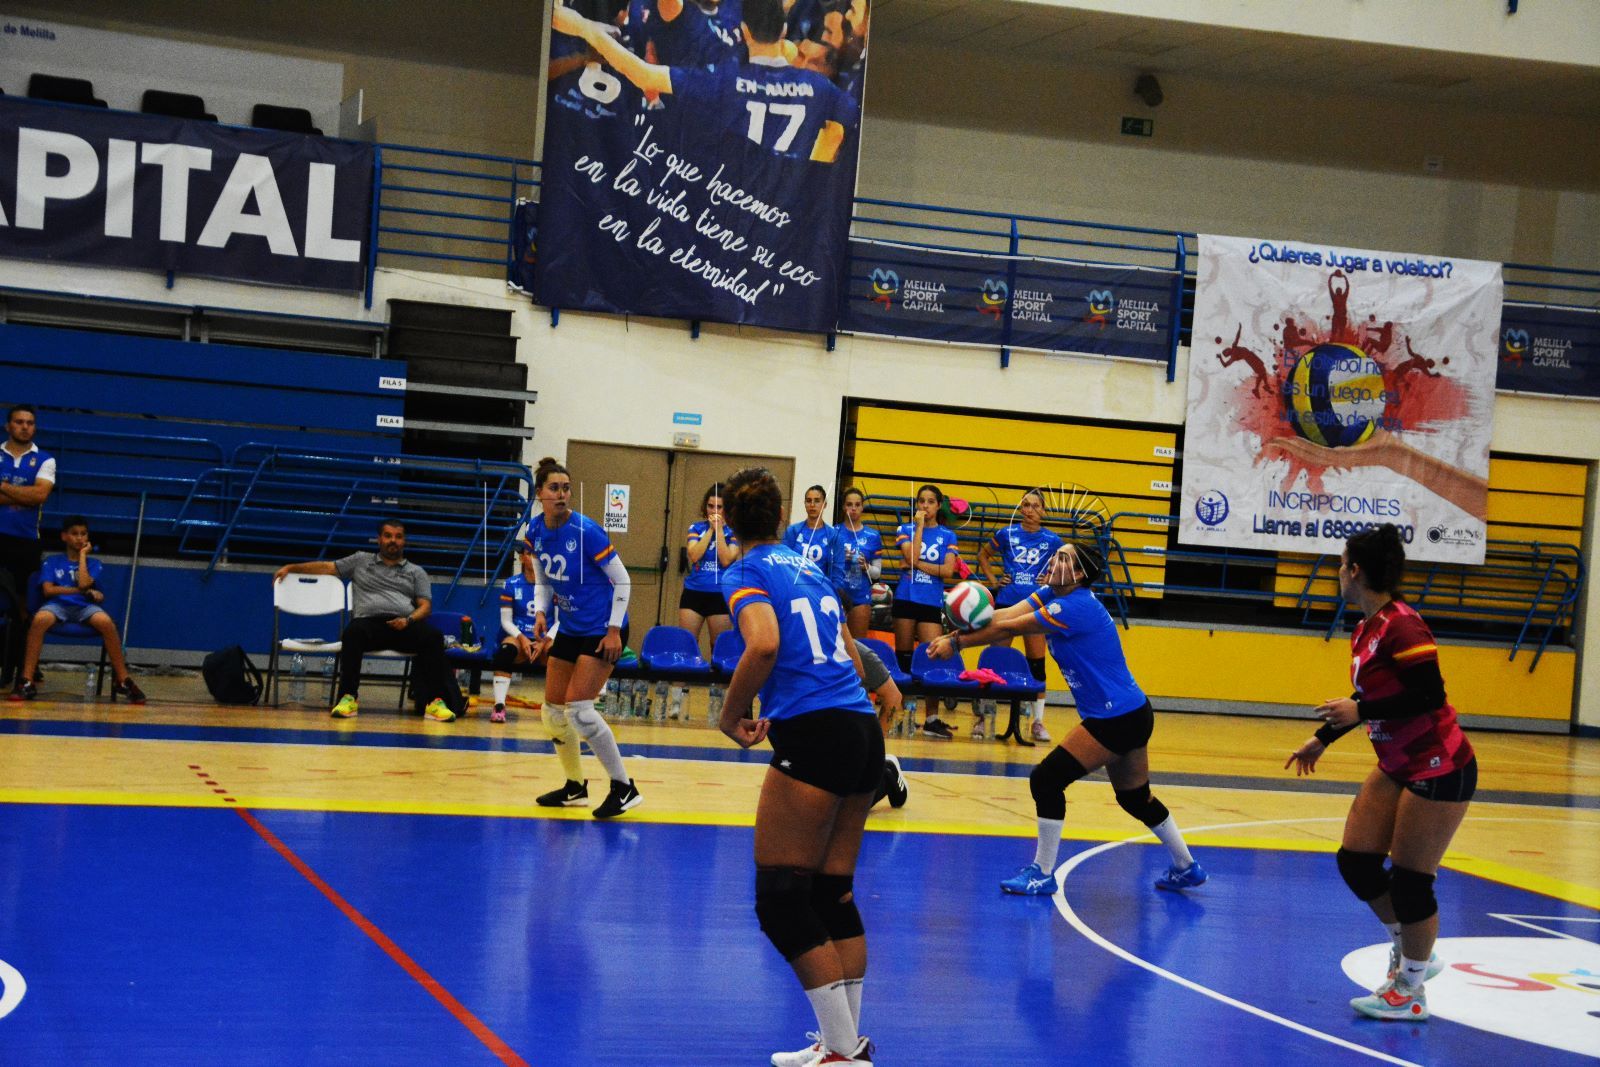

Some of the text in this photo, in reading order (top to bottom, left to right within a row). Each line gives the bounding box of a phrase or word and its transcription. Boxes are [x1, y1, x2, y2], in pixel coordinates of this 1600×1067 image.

[3, 22, 56, 41] de Melilla
[746, 100, 806, 152] 17
[0, 127, 361, 263] PITAL
[660, 153, 702, 187] que
[706, 164, 791, 228] hacemos
[574, 155, 821, 286] en la vida tiene su eco
[598, 214, 630, 242] en
[637, 217, 665, 255] la
[1248, 241, 1453, 279] ¿Quieres Jugar a voleibol?
[903, 290, 938, 301] SPORT
[904, 280, 946, 293] MELILLA
[1013, 289, 1053, 303] MELILLA
[902, 300, 944, 313] CAPITAL
[1012, 300, 1045, 311] SPORT
[1117, 309, 1151, 321] SPORT
[1119, 299, 1159, 312] MELILLA
[1011, 310, 1052, 323] CAPITAL
[1116, 319, 1157, 332] CAPITAL
[1532, 337, 1573, 350] MELILLA
[1532, 347, 1565, 358] SPORT
[1531, 357, 1571, 368] CAPITAL
[1268, 490, 1401, 517] INCRIPCIONES
[1253, 514, 1302, 536] Llama
[1305, 518, 1319, 538] al
[801, 543, 823, 562] 10
[1013, 545, 1040, 565] 28
[540, 553, 570, 581] 22
[791, 595, 852, 665] 12
